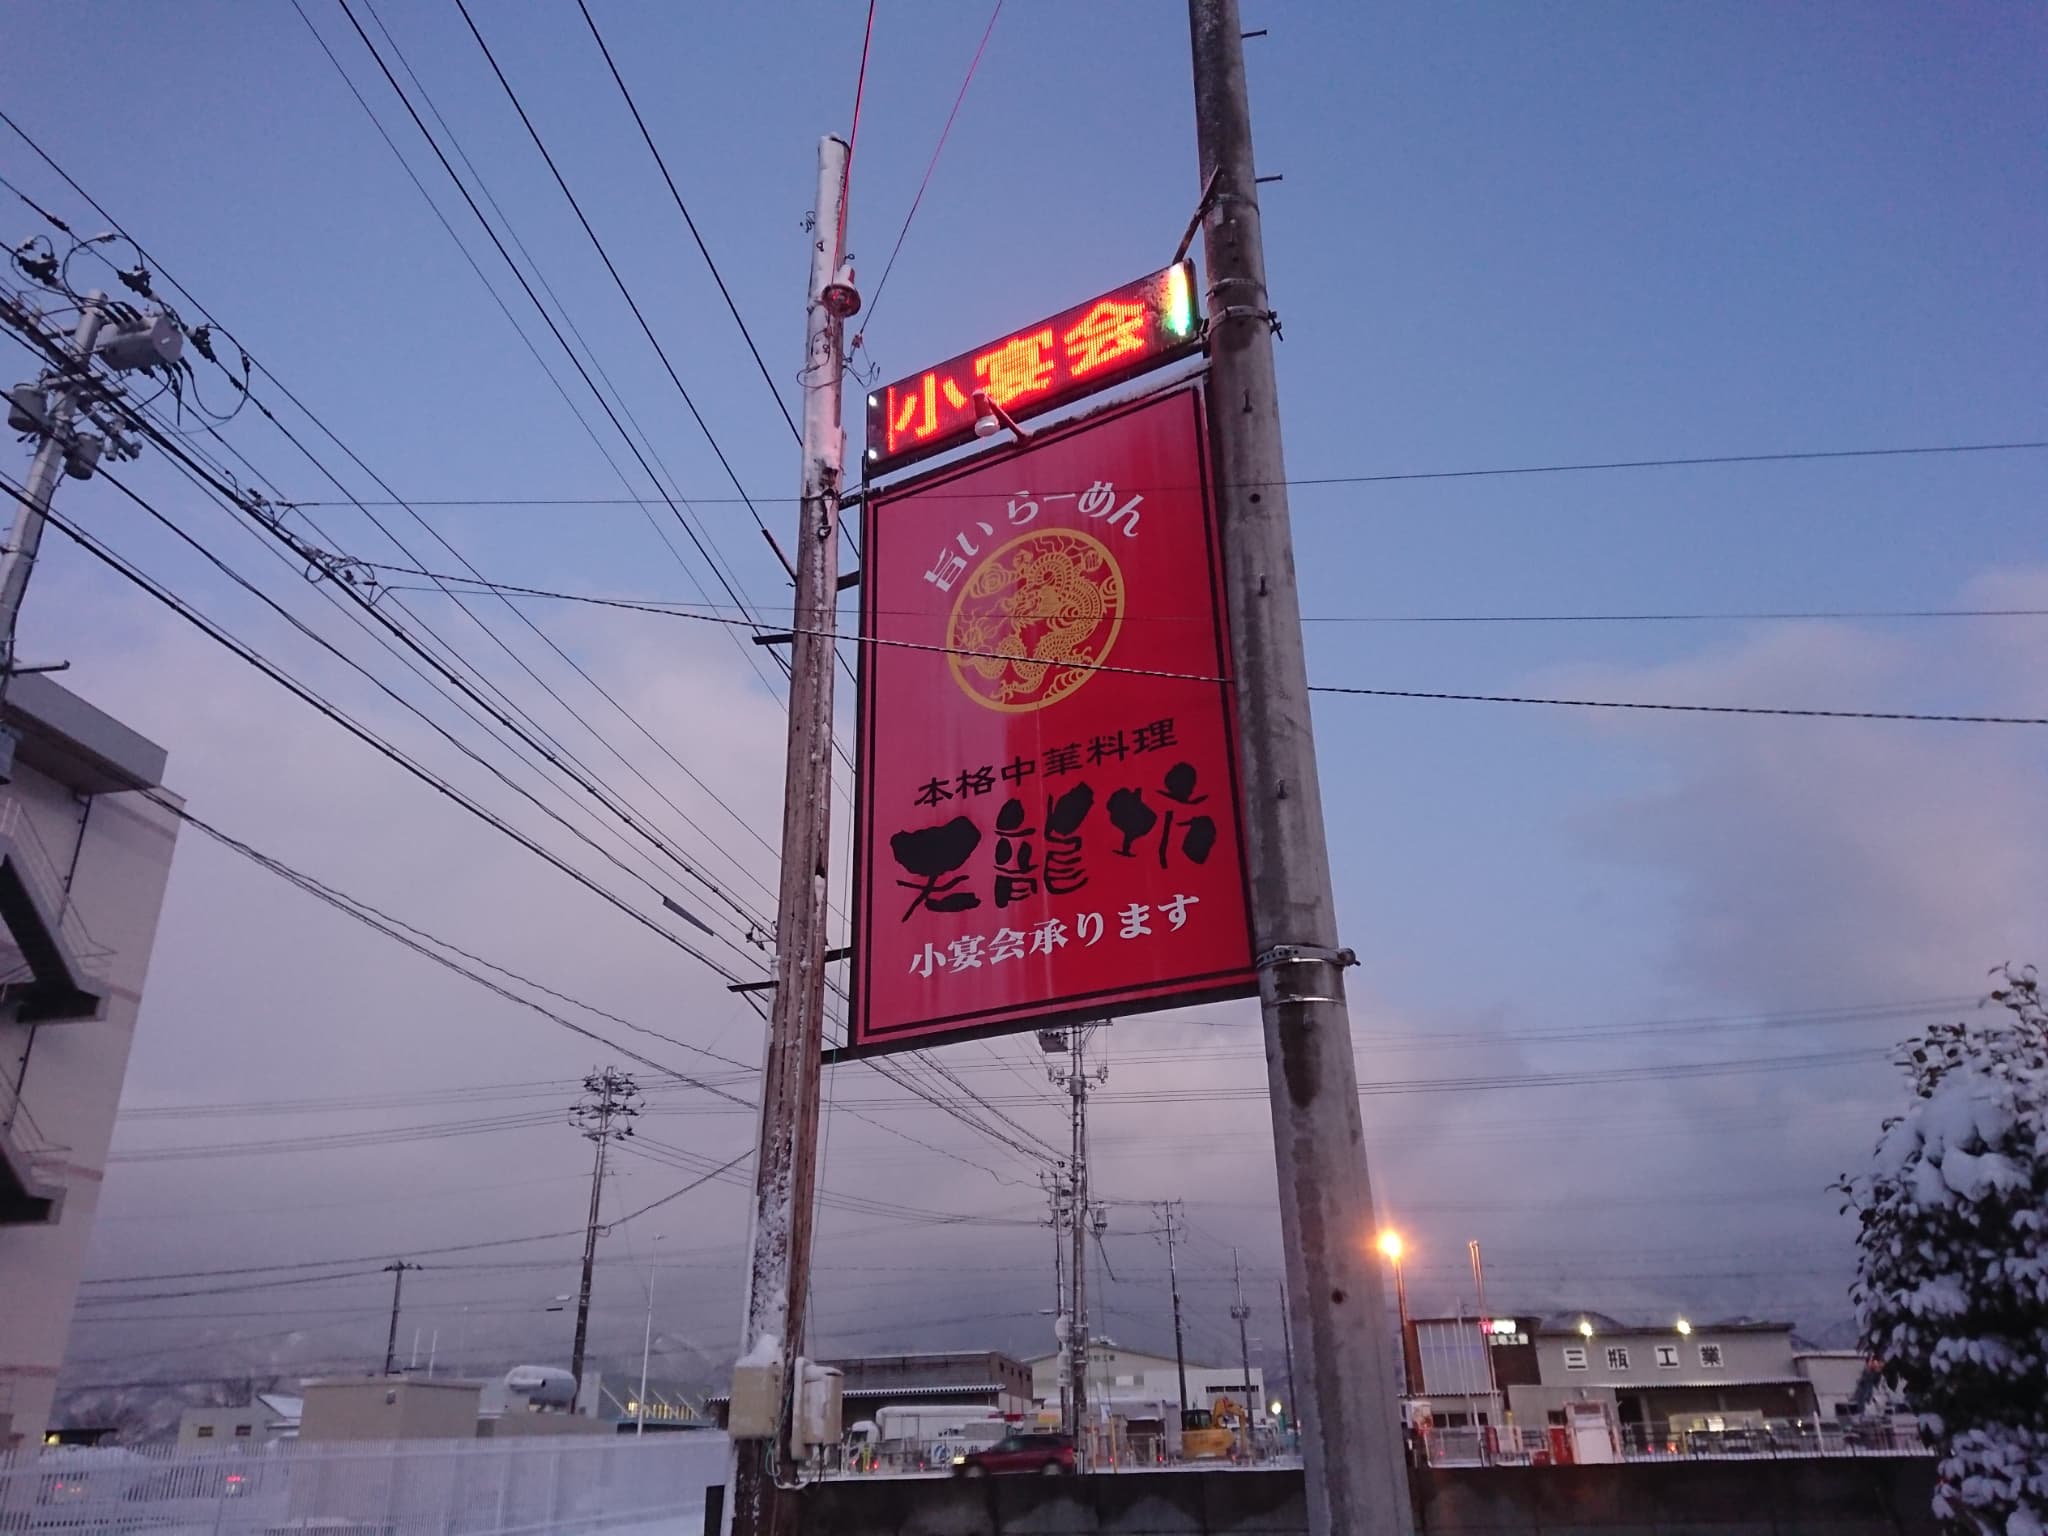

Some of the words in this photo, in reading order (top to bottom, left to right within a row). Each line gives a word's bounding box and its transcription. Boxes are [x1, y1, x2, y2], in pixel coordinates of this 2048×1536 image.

[894, 301, 1145, 438] 小宴会
[914, 718, 1177, 807] 本格中華料理
[908, 894, 1200, 978] 小宴会承ります
